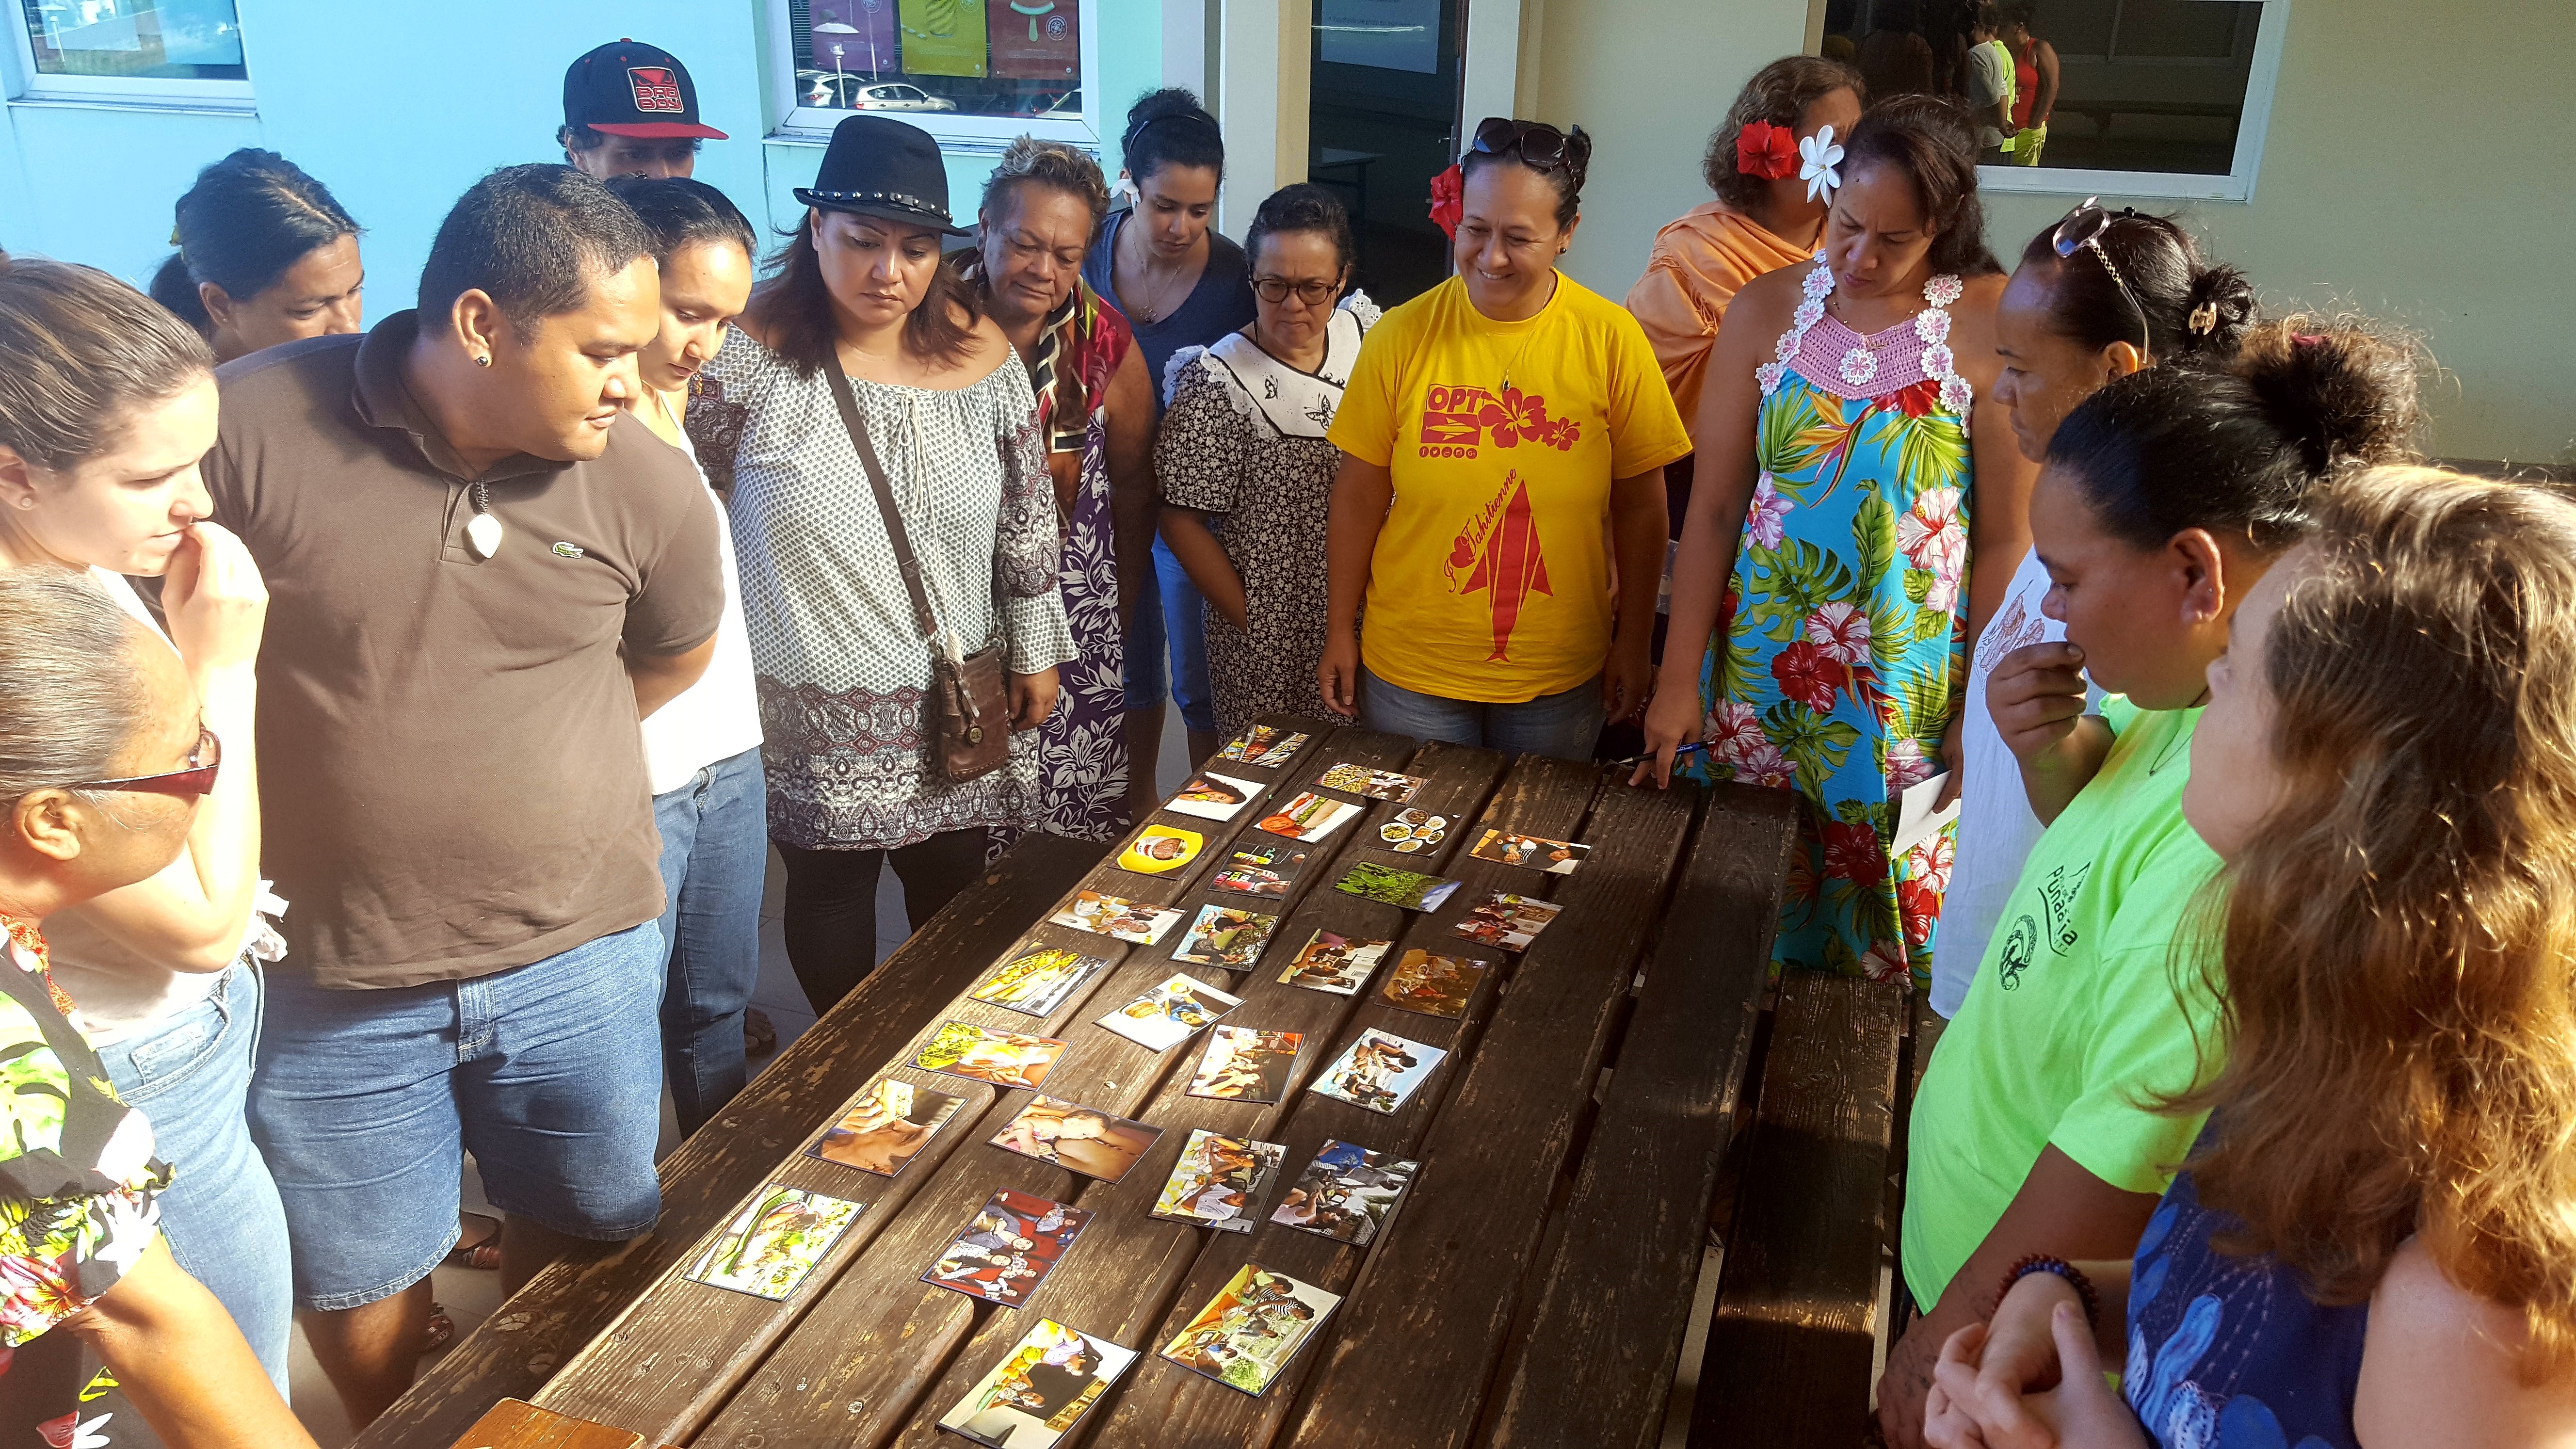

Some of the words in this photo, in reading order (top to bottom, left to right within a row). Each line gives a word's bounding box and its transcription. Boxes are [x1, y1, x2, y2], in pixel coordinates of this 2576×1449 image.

[635, 86, 680, 98] BAD
[638, 97, 682, 110] BOY
[1428, 387, 1482, 413] OPT
[1459, 468, 1517, 560] Tahitienne
